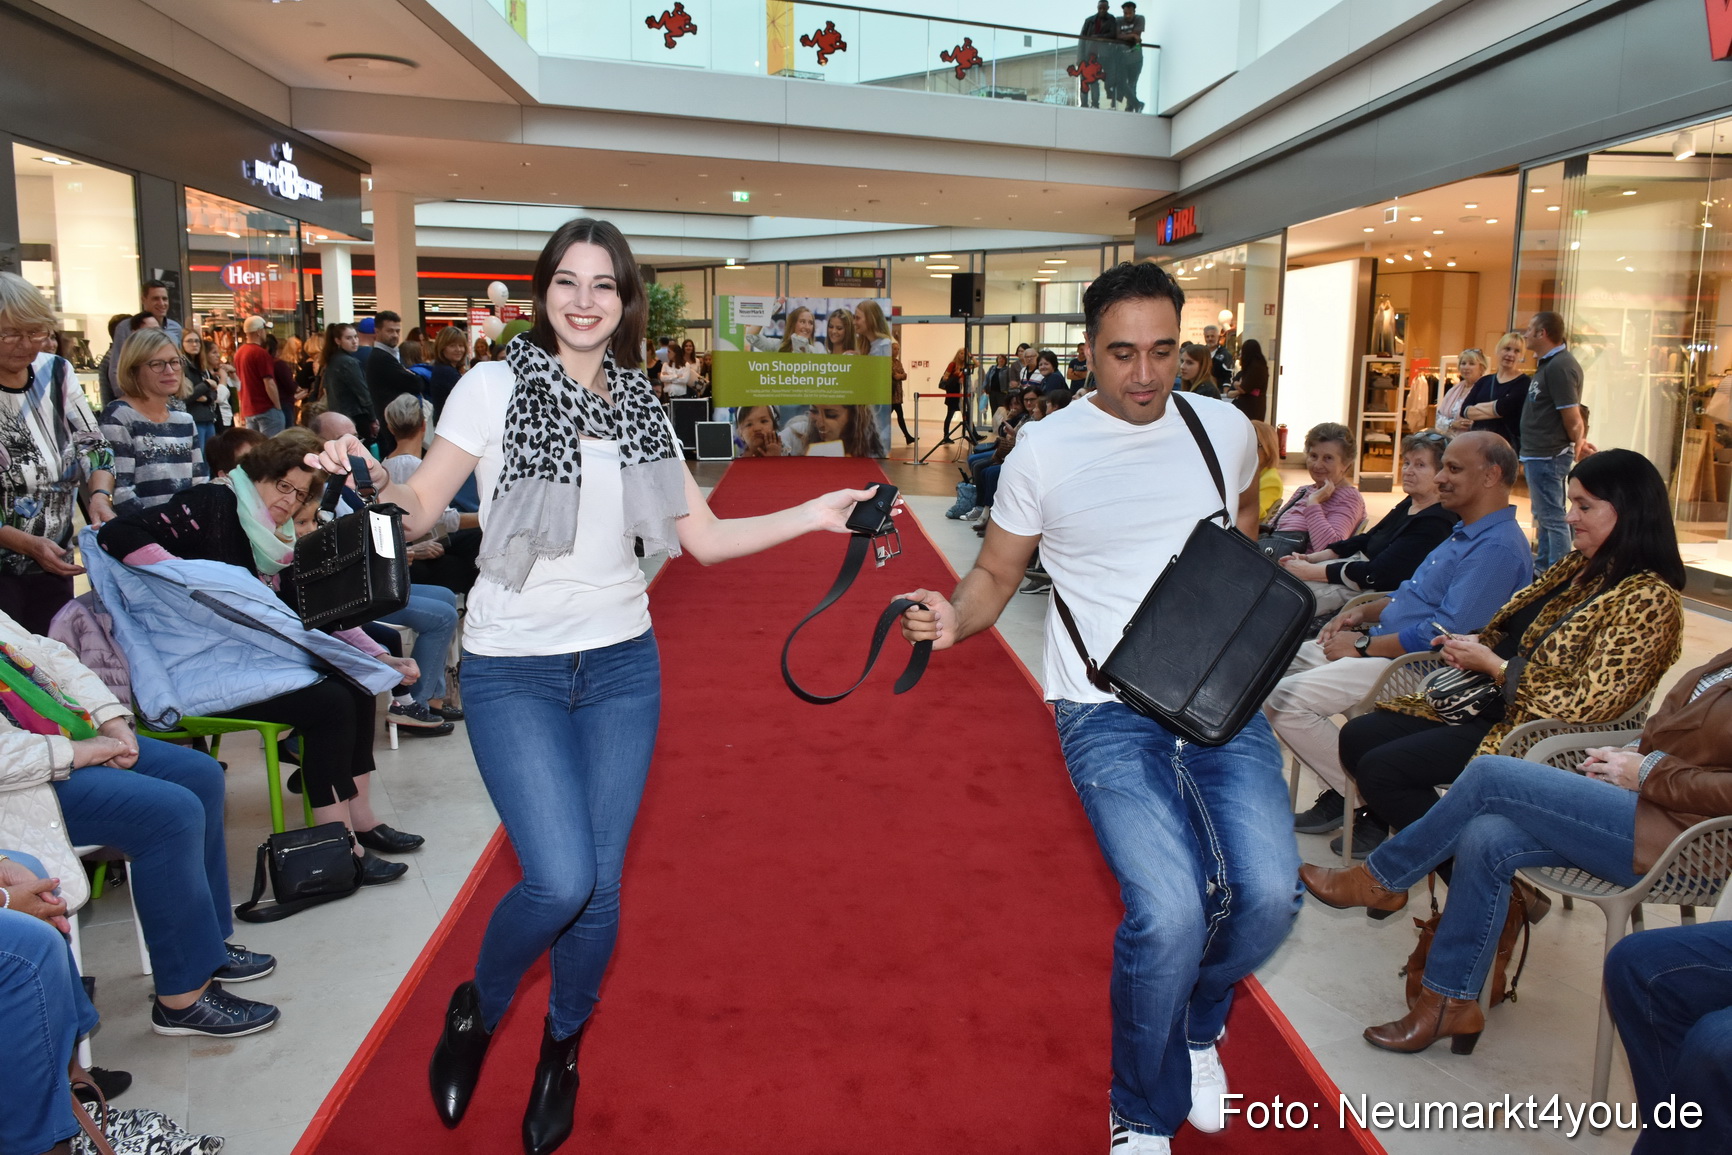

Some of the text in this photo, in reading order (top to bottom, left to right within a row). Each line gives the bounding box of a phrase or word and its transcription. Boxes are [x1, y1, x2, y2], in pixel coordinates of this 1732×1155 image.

[1156, 205, 1198, 247] WÖHRL
[748, 360, 852, 374] Von Shoppingtour
[759, 374, 839, 388] bis Leben pur.
